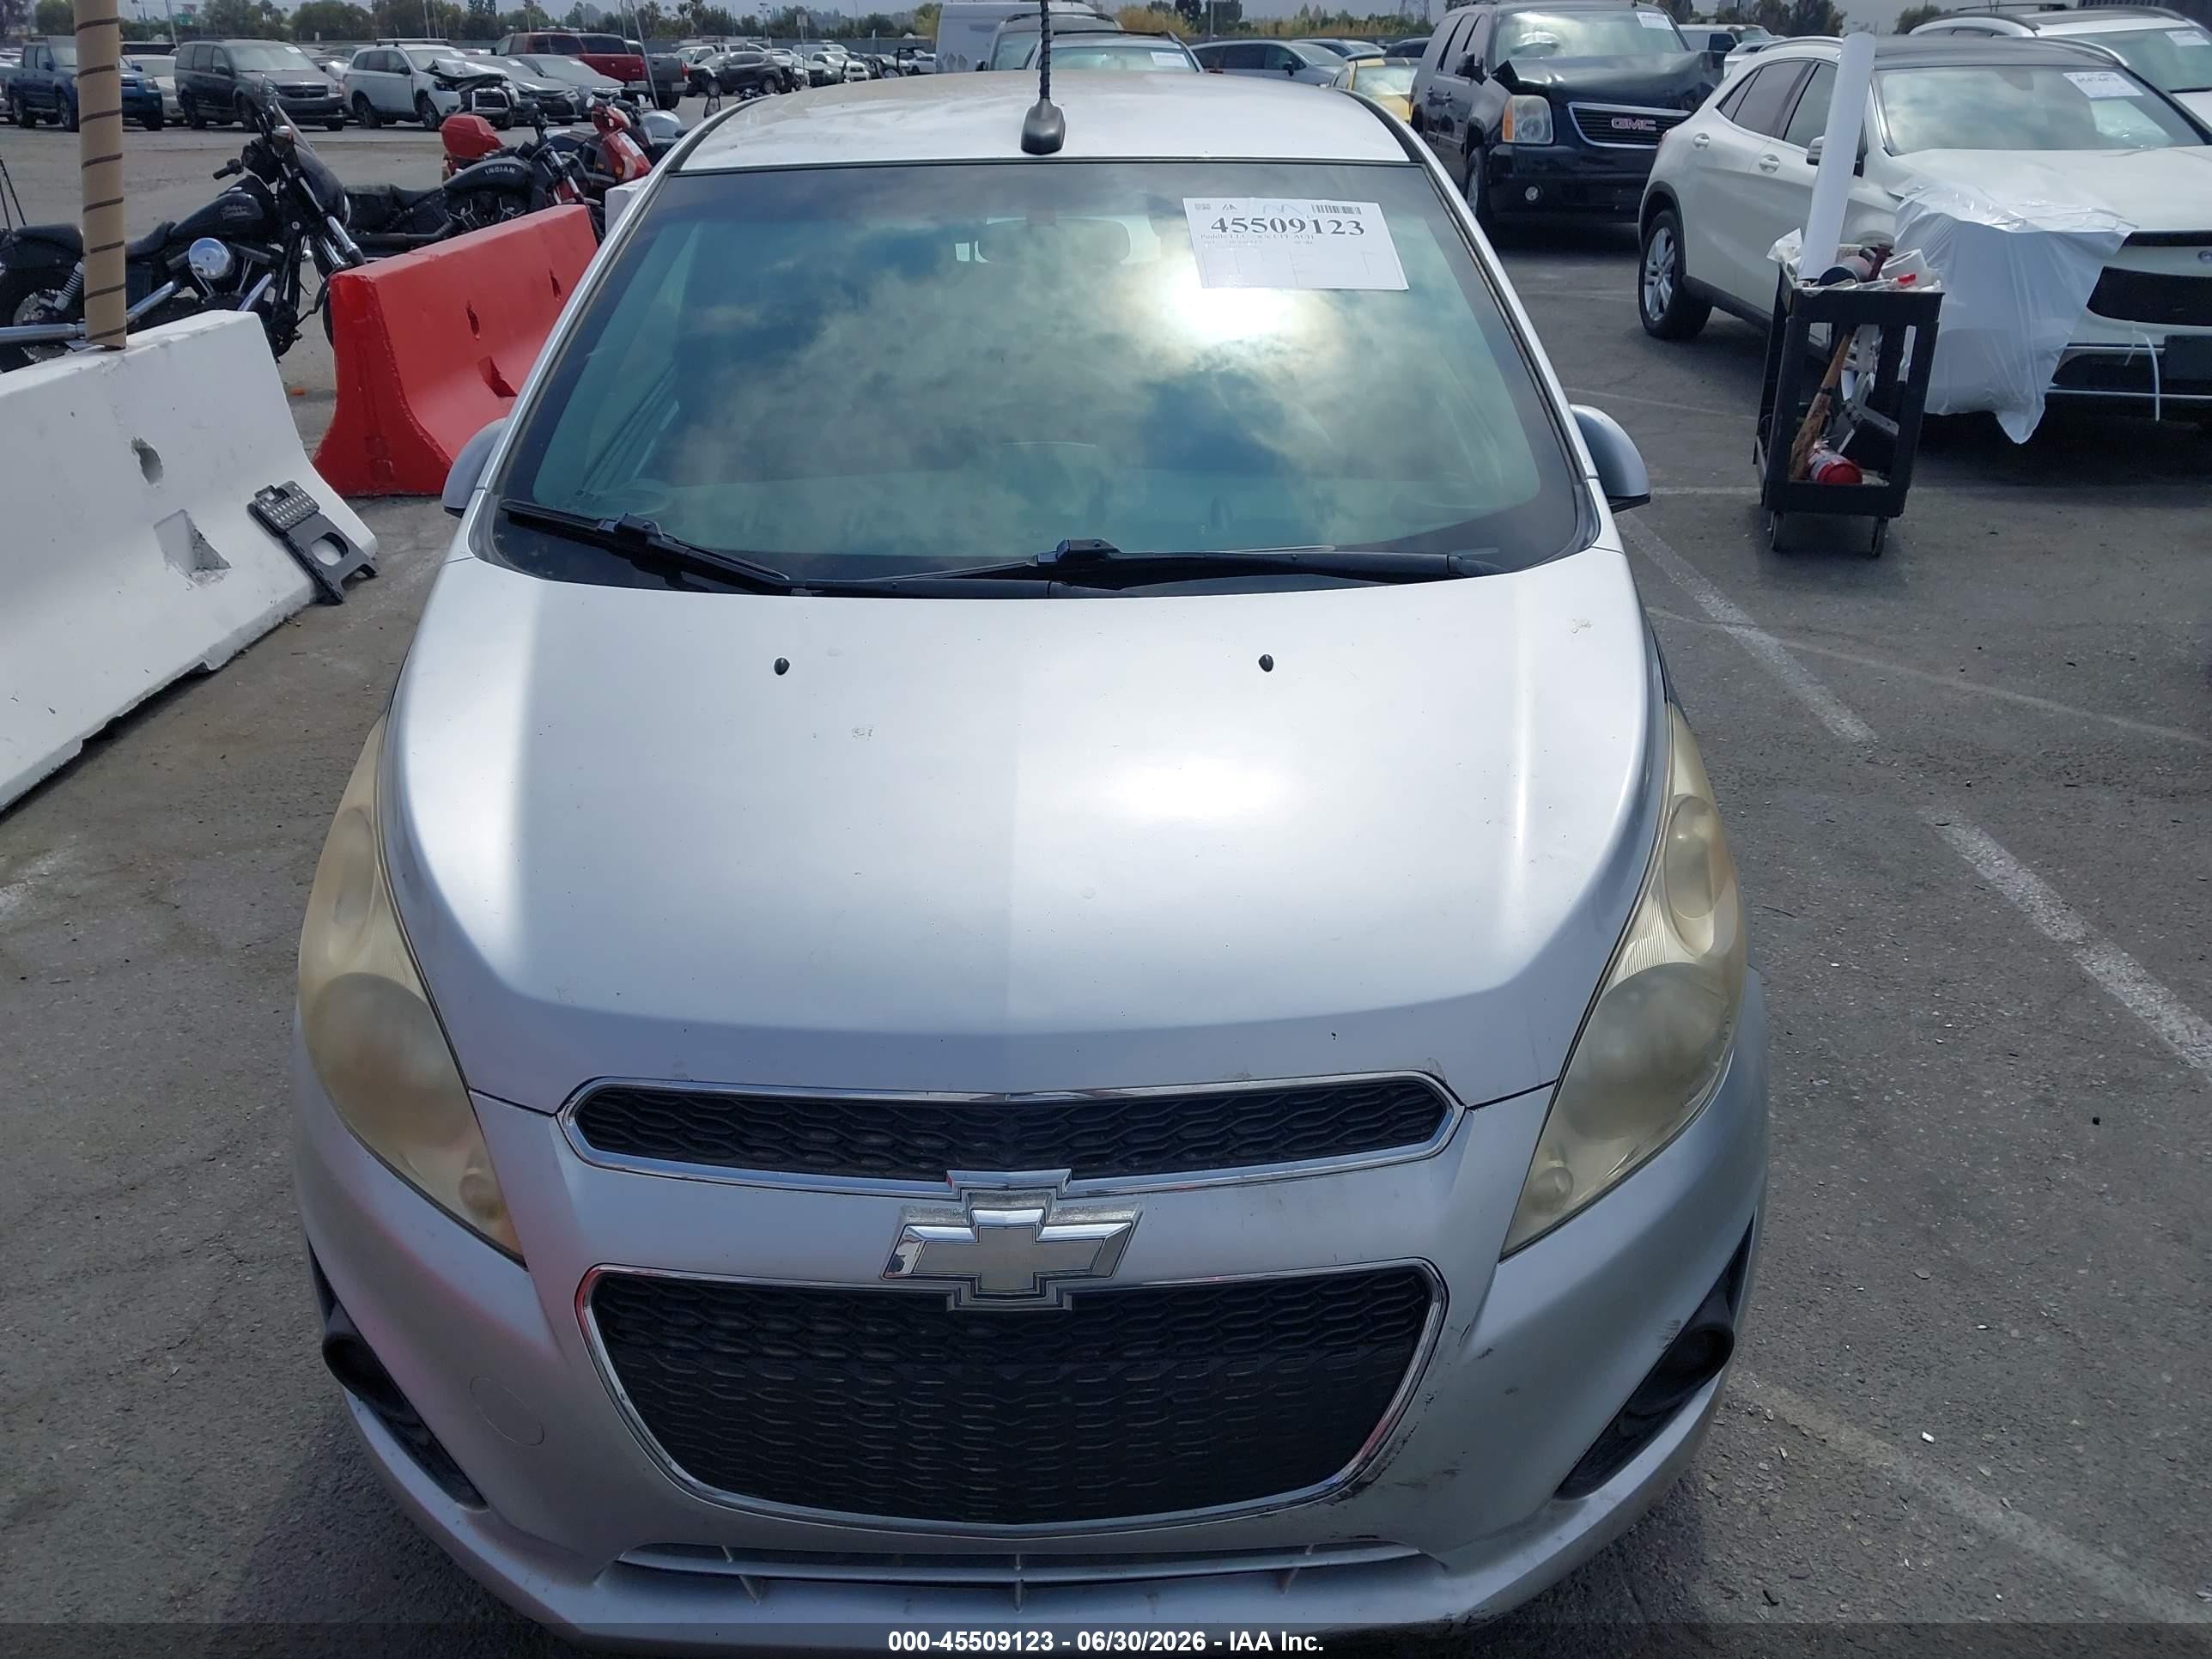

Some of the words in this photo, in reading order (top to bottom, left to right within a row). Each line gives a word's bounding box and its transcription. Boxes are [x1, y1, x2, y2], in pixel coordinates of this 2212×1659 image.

[1611, 118, 1656, 131] GMC
[484, 166, 516, 174] INDIAN
[1210, 216, 1365, 236] 45509123
